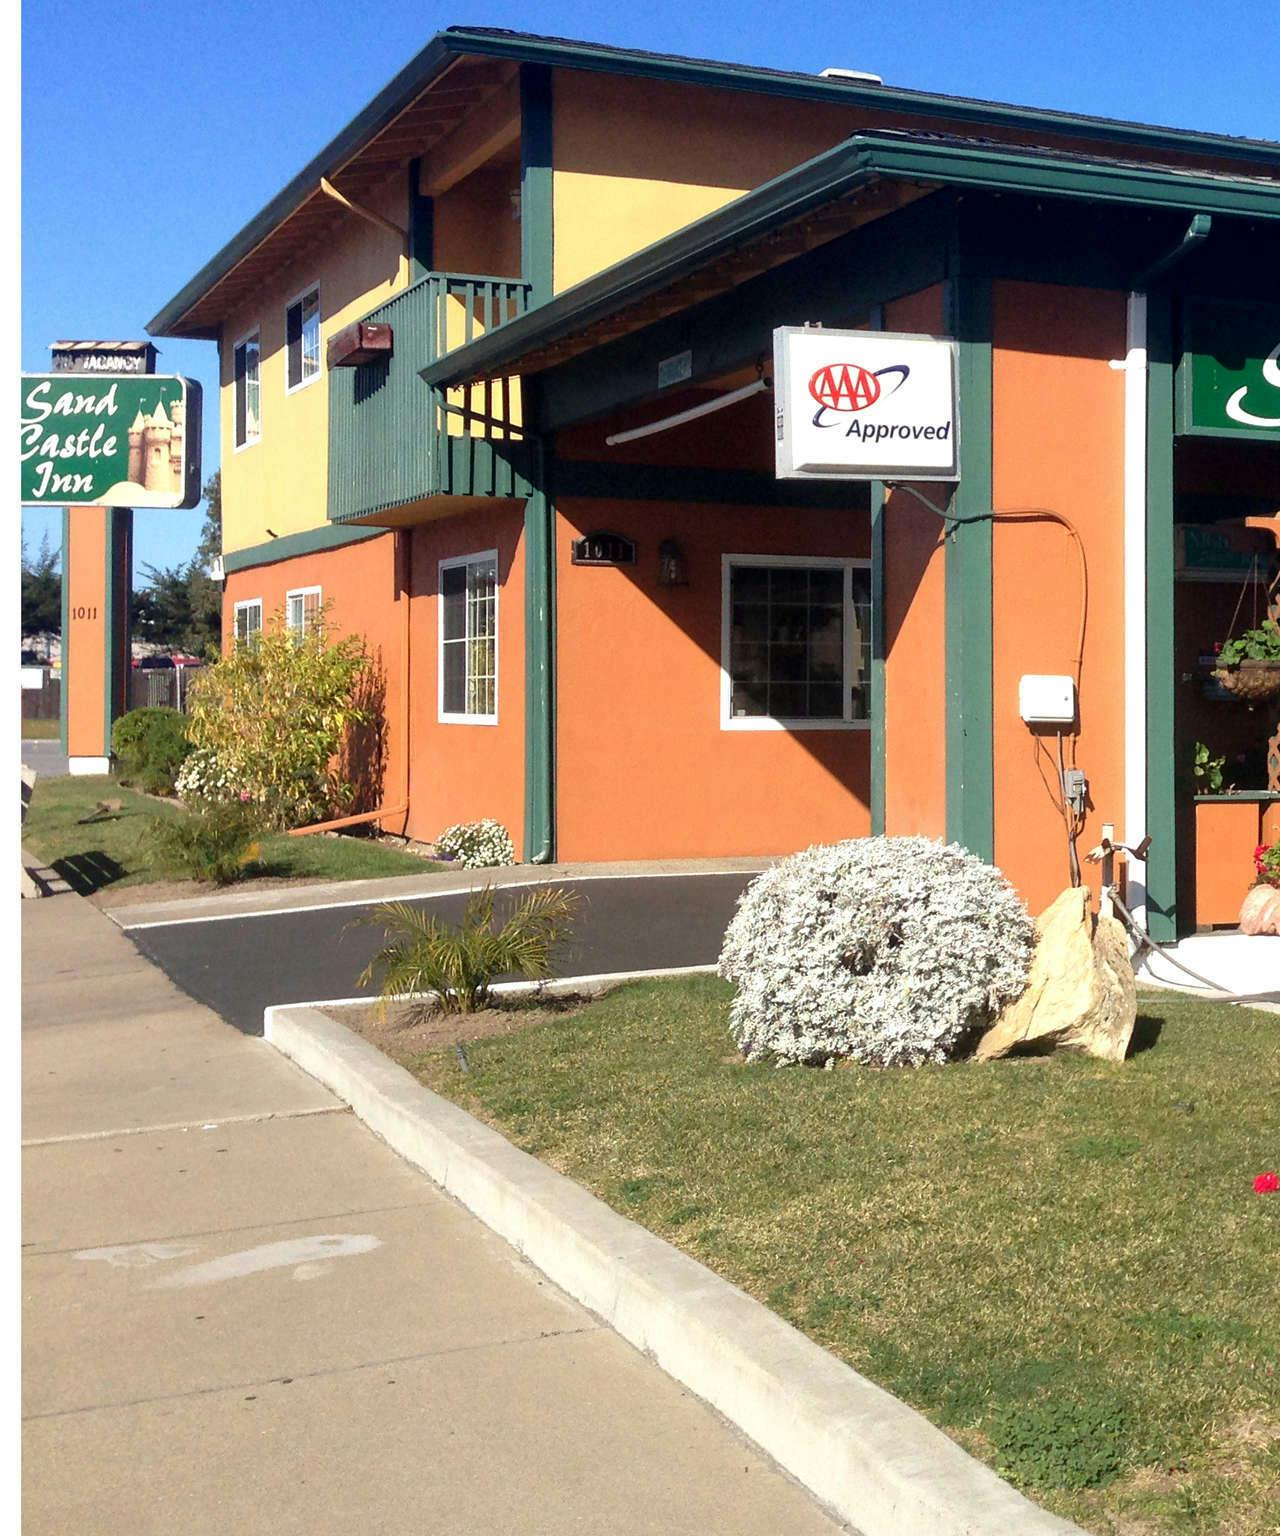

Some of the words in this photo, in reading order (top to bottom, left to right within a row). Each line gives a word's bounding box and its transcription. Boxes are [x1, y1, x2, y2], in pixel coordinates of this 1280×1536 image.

[21, 381, 118, 424] Sand
[814, 366, 876, 411] AAA
[21, 423, 117, 461] Castle
[845, 419, 951, 443] Approved
[32, 461, 93, 498] Inn
[72, 607, 97, 620] 1011
